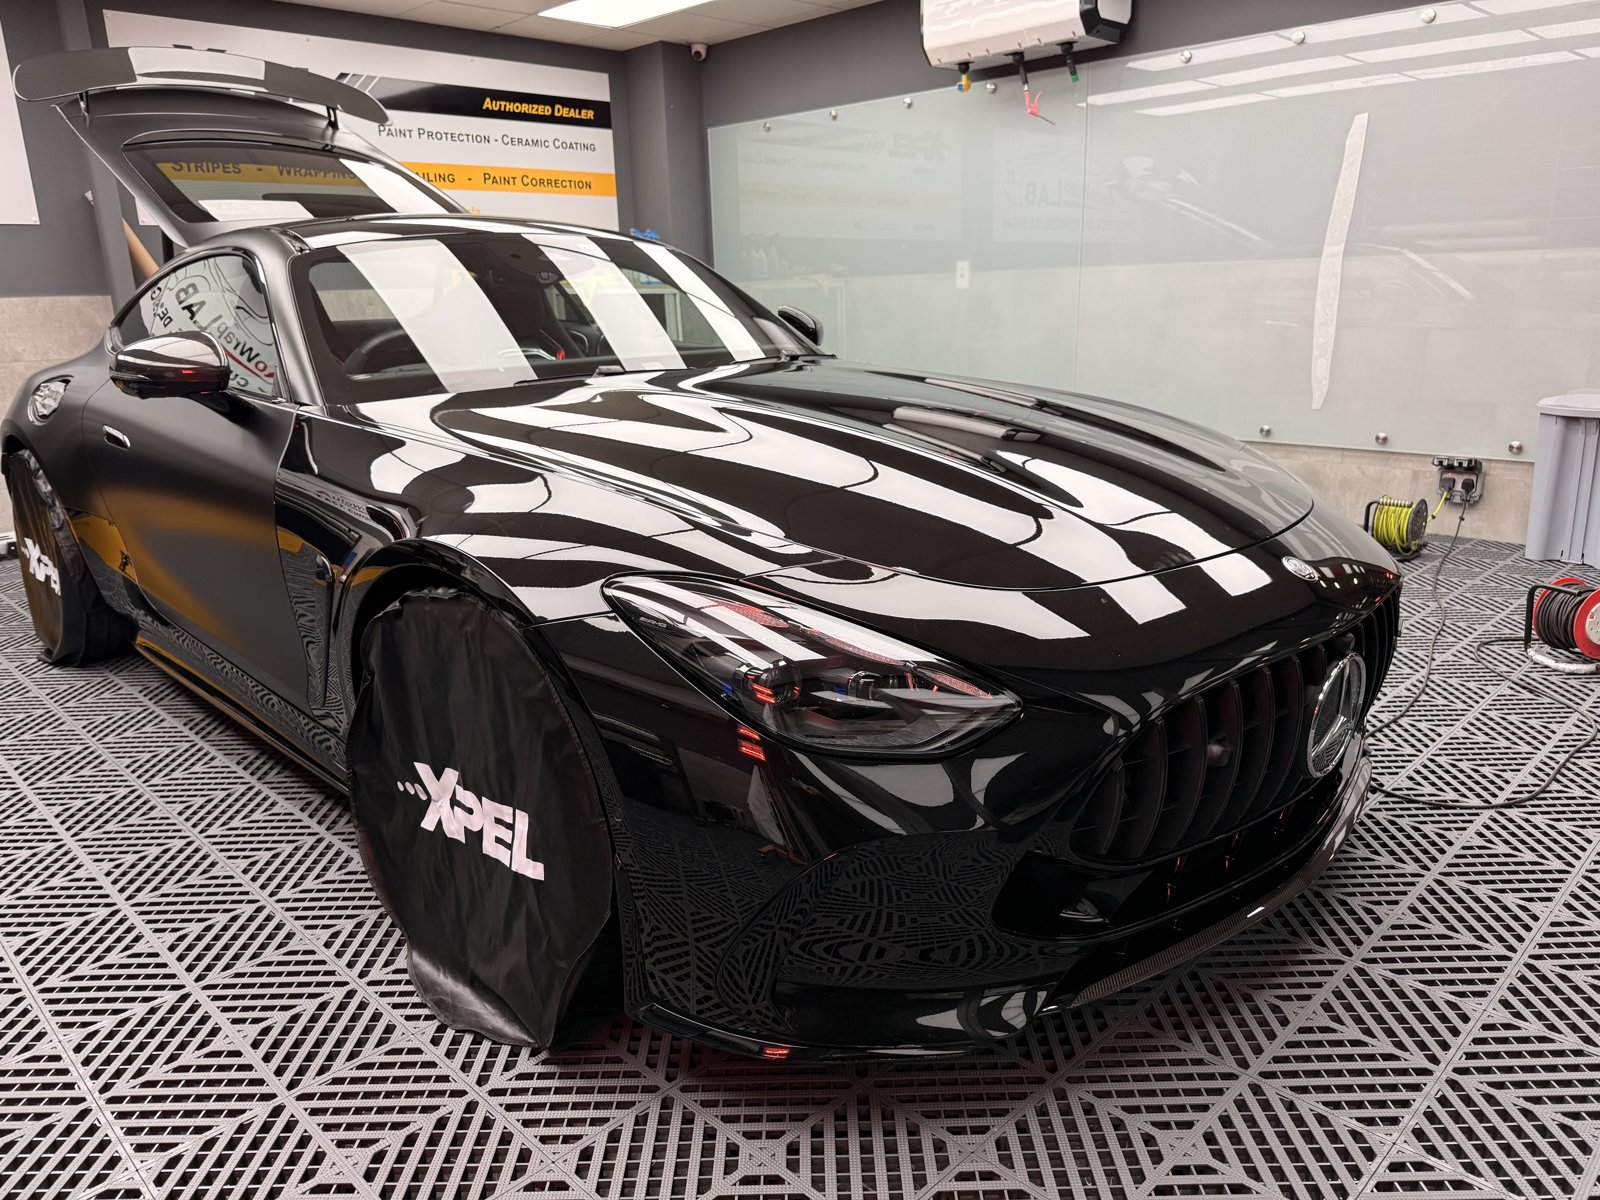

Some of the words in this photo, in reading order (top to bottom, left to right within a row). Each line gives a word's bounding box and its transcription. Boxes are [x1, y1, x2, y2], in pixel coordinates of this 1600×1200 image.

[482, 97, 552, 116] AUTHORIZED
[554, 104, 595, 120] DEALER
[377, 125, 414, 138] PAINT
[417, 127, 490, 144] PROTECTION
[501, 134, 550, 148] CERAMIC
[552, 138, 596, 152] COATING
[483, 173, 516, 186] PAINT
[521, 174, 592, 190] CORRECTION
[414, 762, 545, 881] XPEL
